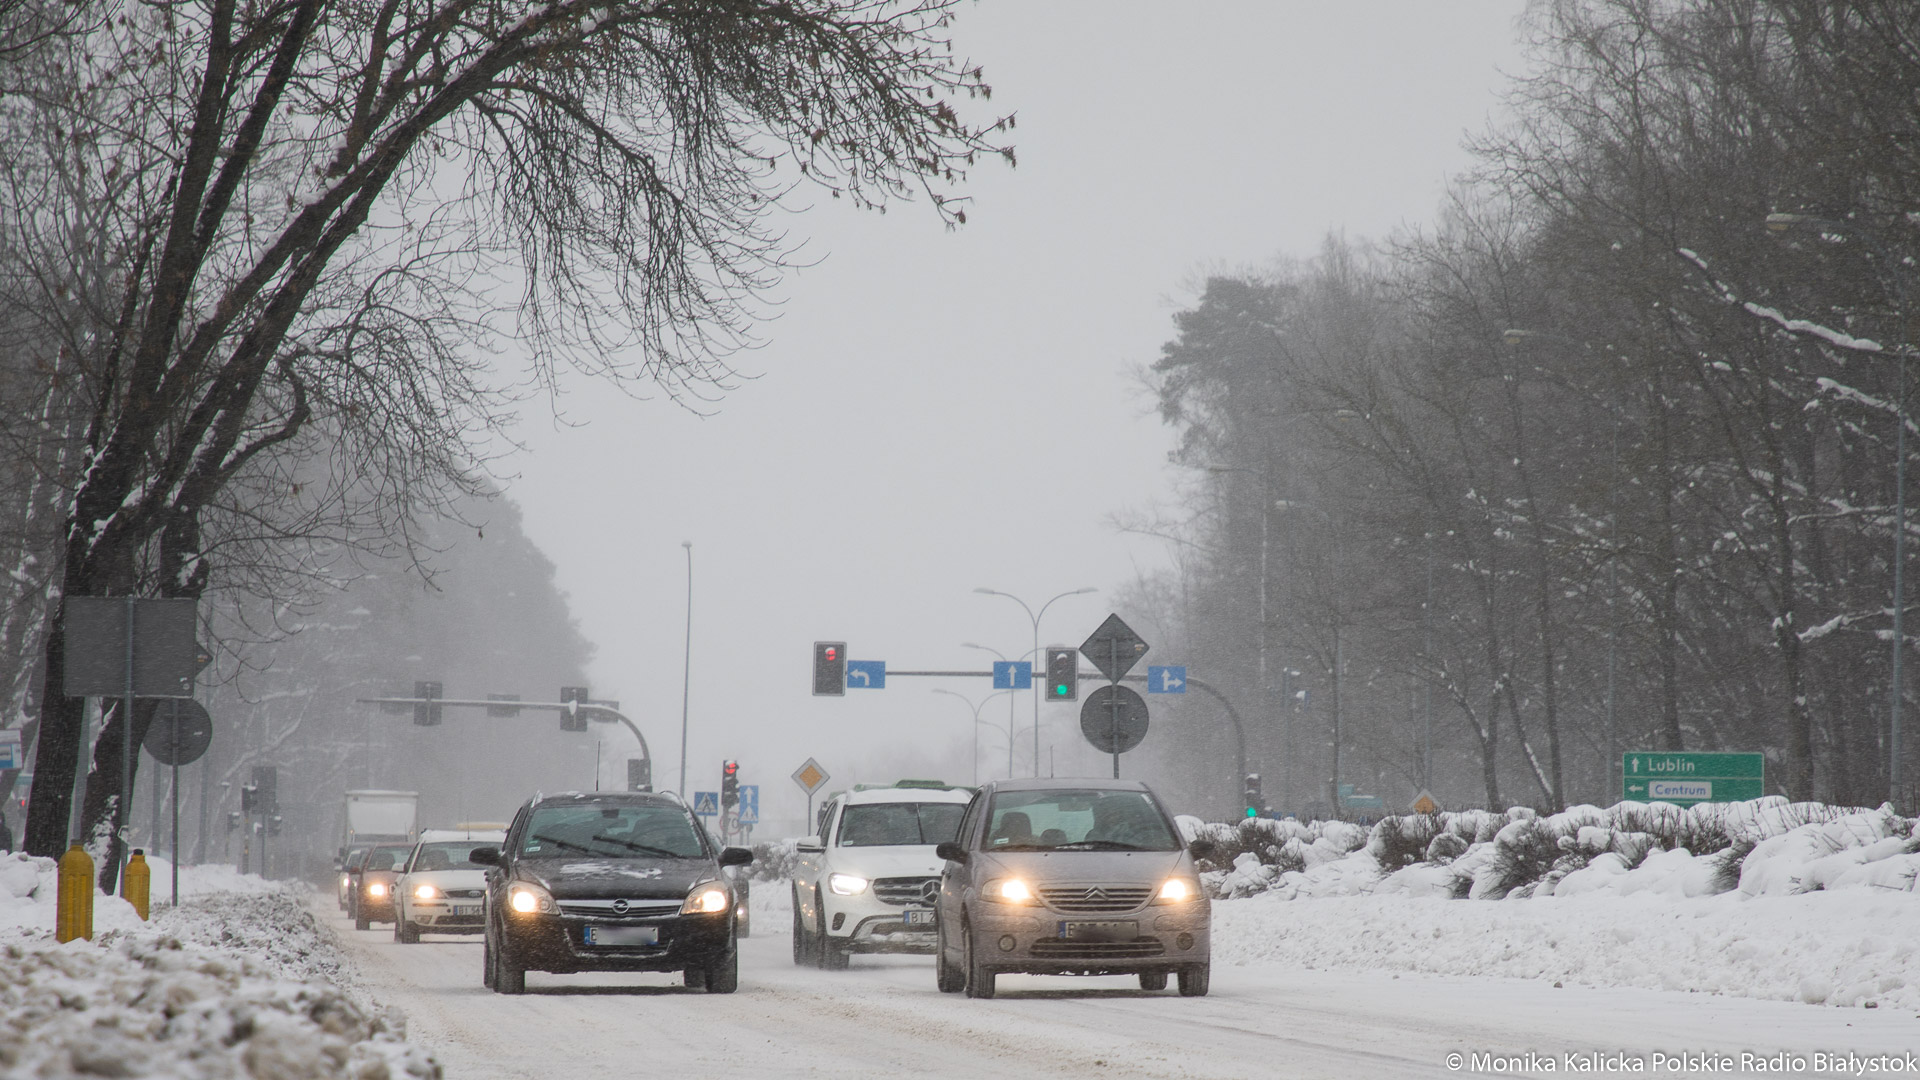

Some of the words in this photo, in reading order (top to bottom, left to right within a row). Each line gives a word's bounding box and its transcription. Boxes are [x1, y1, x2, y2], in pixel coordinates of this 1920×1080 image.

[1648, 758, 1695, 772] Lublin
[1655, 784, 1706, 795] Centrum
[911, 912, 923, 923] BI
